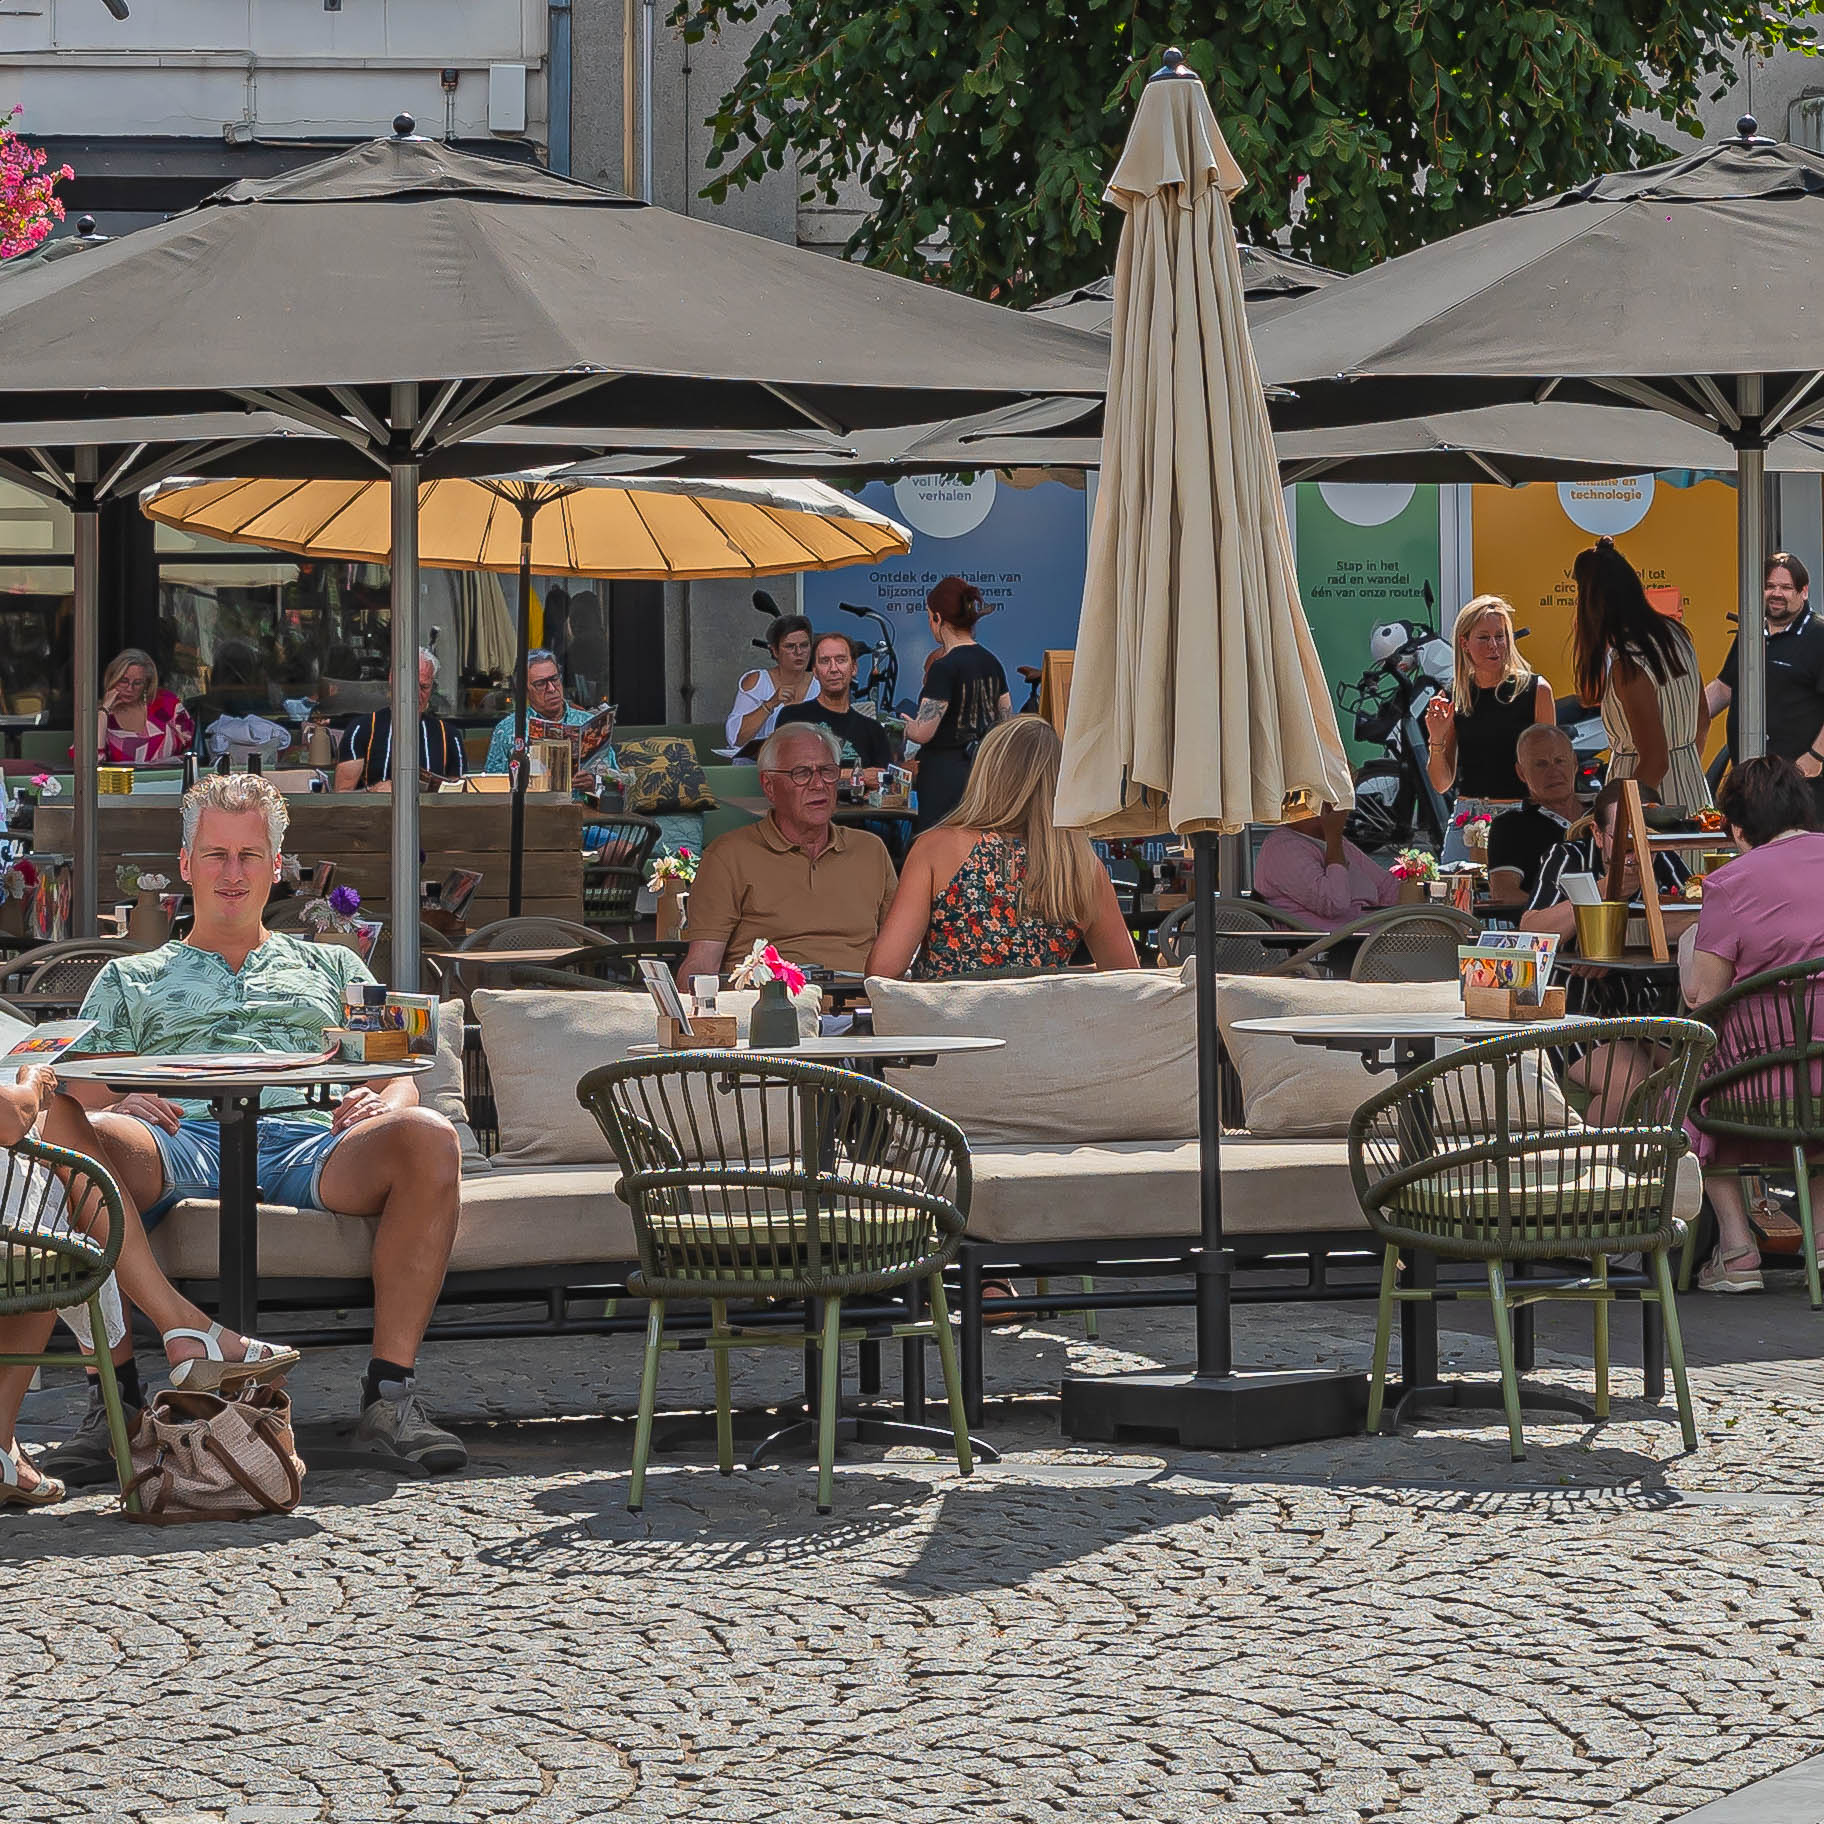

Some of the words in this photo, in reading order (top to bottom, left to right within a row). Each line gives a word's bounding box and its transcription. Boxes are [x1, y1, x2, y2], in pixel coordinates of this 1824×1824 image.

[918, 490, 972, 501] verhalen
[1570, 489, 1642, 502] technologie
[1336, 560, 1363, 572] Stap
[1367, 560, 1377, 571] in
[1380, 560, 1400, 571] het
[869, 571, 917, 583] Ontdek
[920, 571, 938, 583] de
[998, 573, 1022, 583] van
[1327, 573, 1346, 584] rad
[1349, 575, 1364, 584] en
[1367, 573, 1410, 584] wandel
[1648, 569, 1666, 580] tot
[1311, 584, 1332, 598] één
[1334, 588, 1356, 598] van
[1359, 588, 1387, 598] onze
[1540, 595, 1553, 606] all
[886, 603, 902, 612] en
